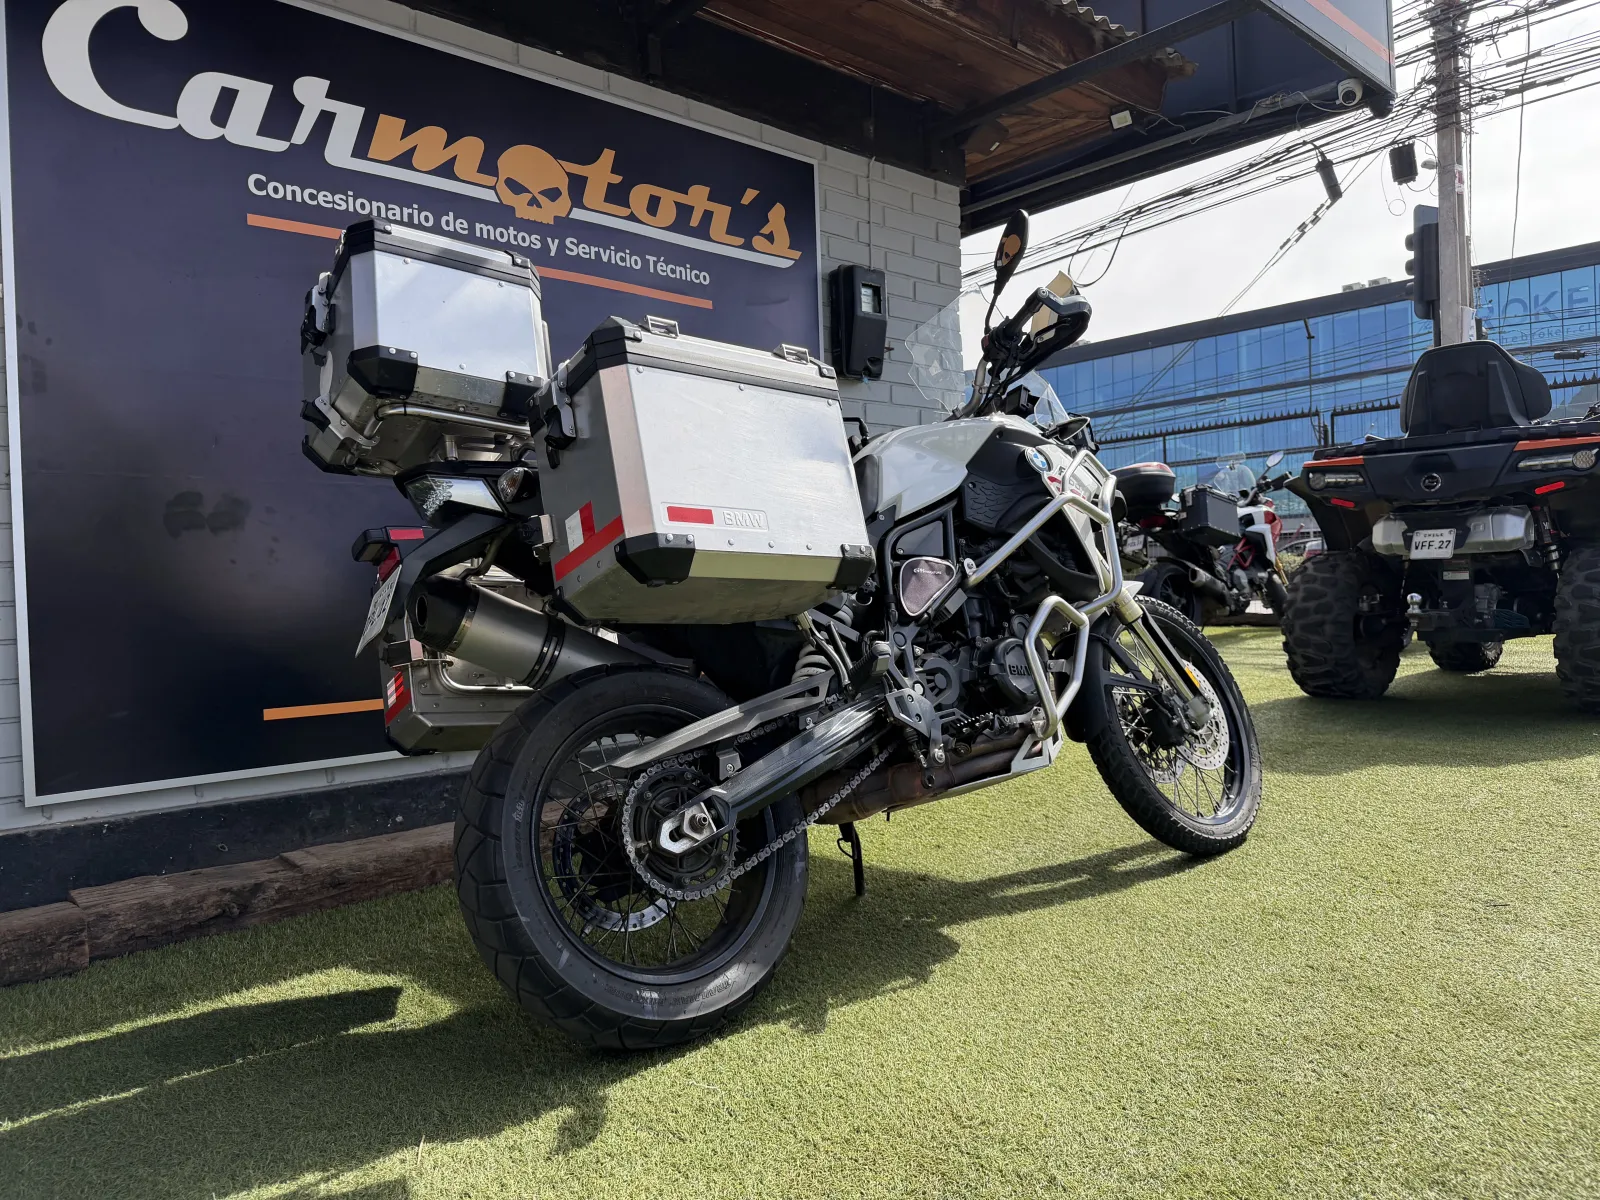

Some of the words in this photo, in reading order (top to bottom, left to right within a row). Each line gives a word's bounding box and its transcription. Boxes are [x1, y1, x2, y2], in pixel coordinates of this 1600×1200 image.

[247, 173, 434, 227] Concesionario
[440, 211, 469, 235] de
[475, 221, 542, 249] motos
[546, 237, 560, 257] y
[565, 237, 642, 270] Servicio
[645, 255, 711, 286] Técnico
[722, 510, 764, 528] BMW
